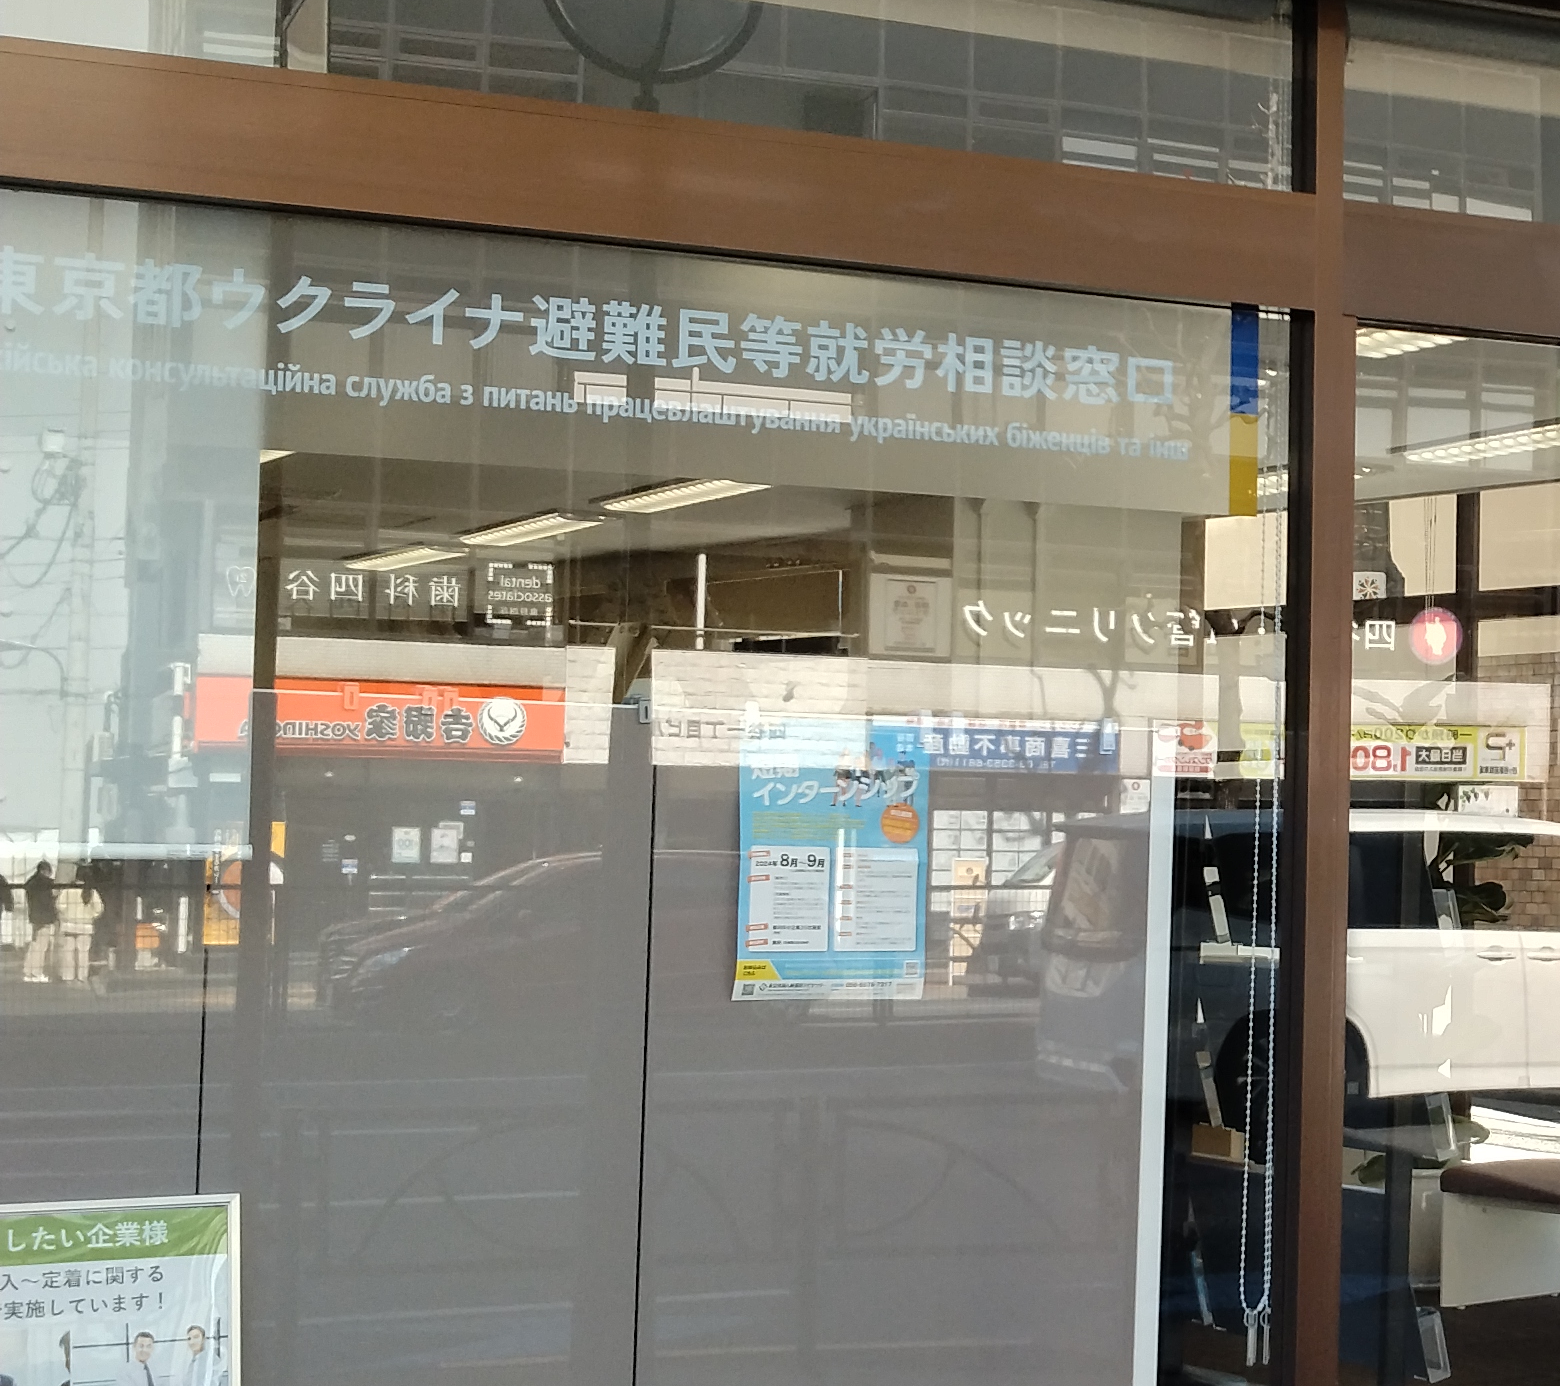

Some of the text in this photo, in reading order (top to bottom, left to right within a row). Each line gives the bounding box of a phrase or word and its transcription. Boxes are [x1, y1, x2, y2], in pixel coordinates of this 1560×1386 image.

[0, 245, 1174, 406] 東京都ウクライナ避難民等就労相談窓口
[0, 342, 98, 378] ійська
[346, 372, 451, 406] служба
[460, 382, 473, 405] з
[483, 384, 578, 414] питань
[586, 392, 841, 435] працевлаштування
[850, 413, 999, 444] українських
[1006, 419, 1111, 458] біженців
[1119, 436, 1141, 457] та
[7, 1219, 169, 1253] したい企業様
[0, 1293, 165, 1321] 実施しています！
